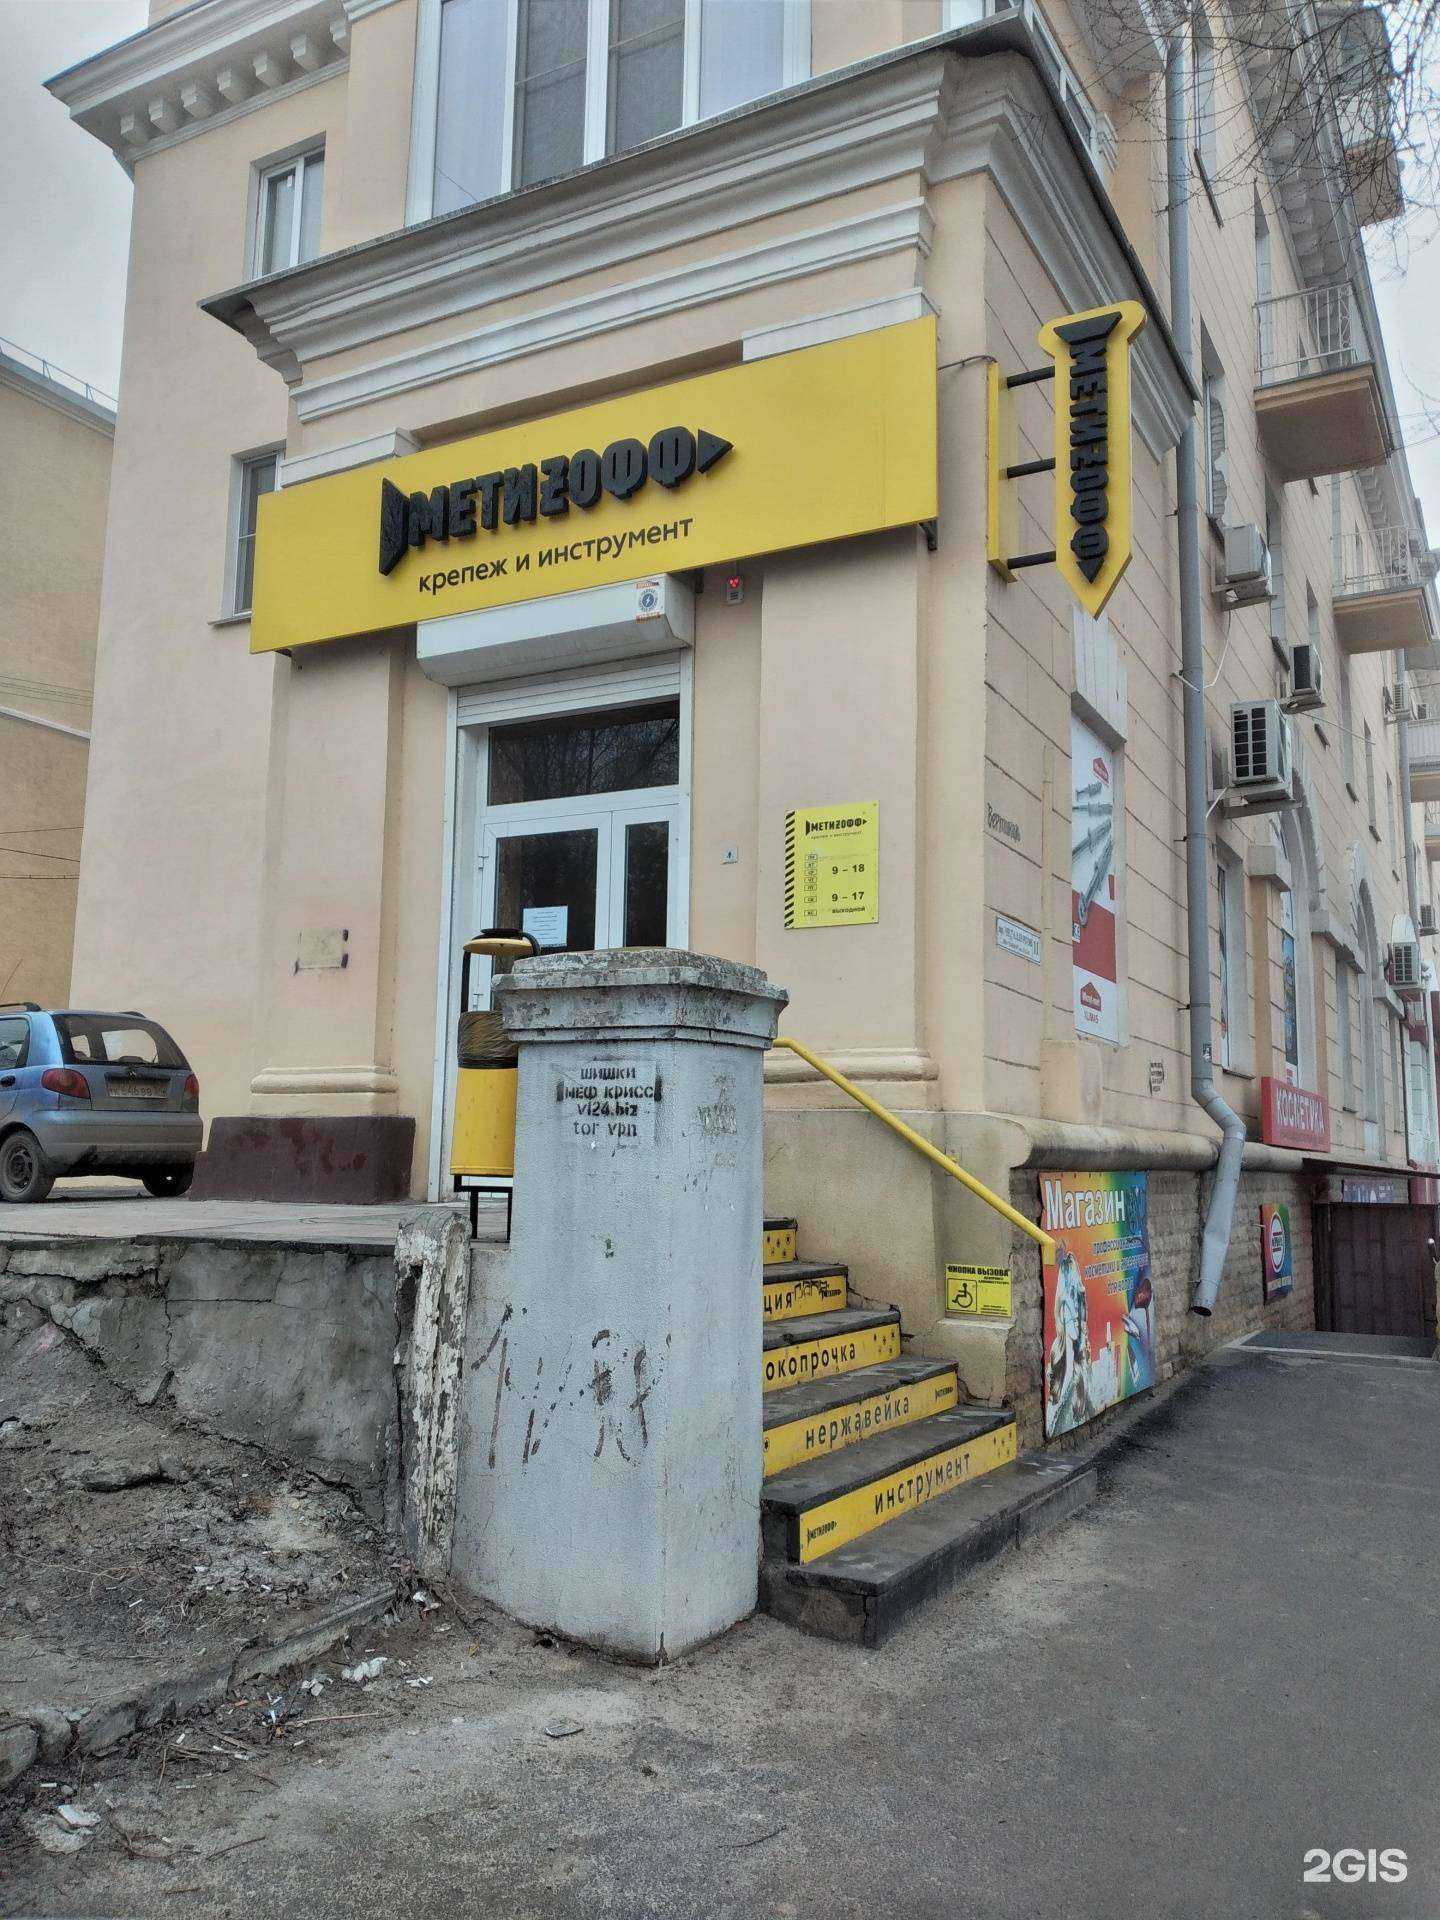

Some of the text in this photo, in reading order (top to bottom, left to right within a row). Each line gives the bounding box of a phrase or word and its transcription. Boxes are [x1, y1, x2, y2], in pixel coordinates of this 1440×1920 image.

[418, 517, 694, 595] крепеж и инструмент
[832, 866, 838, 875] 9
[852, 863, 865, 873] 18
[832, 893, 838, 902] 9
[852, 891, 865, 901] 17
[1044, 1179, 1126, 1231] Магазин
[763, 1292, 792, 1315] ция
[765, 1341, 857, 1381] окопрочка
[804, 1394, 911, 1450] нержавейка
[874, 1452, 971, 1515] инструмент
